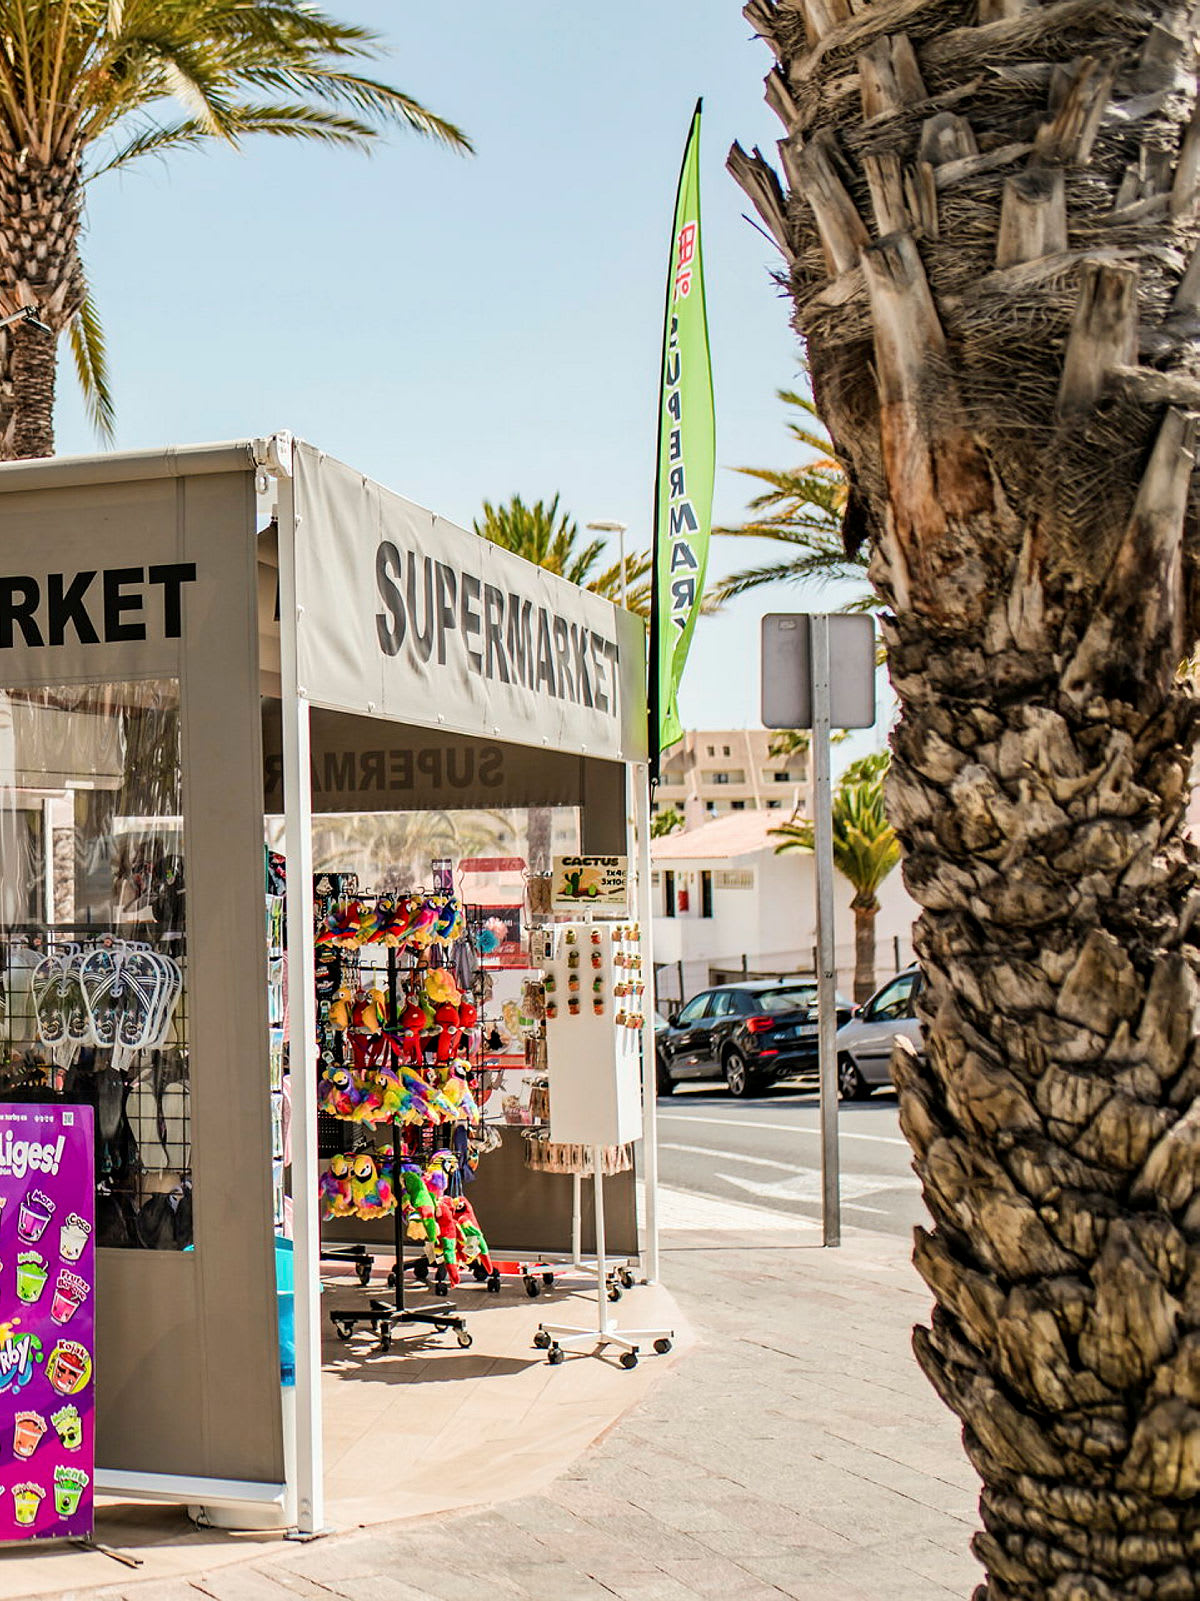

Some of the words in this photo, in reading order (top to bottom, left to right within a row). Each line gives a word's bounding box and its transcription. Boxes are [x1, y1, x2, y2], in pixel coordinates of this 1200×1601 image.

[376, 540, 619, 717] SUPERMARKET
[562, 857, 618, 866] CACTUS
[31, 1189, 56, 1212] Mora
[68, 1213, 91, 1233] Coco
[58, 1340, 87, 1358] Kojak
[54, 1465, 89, 1488] Menta
